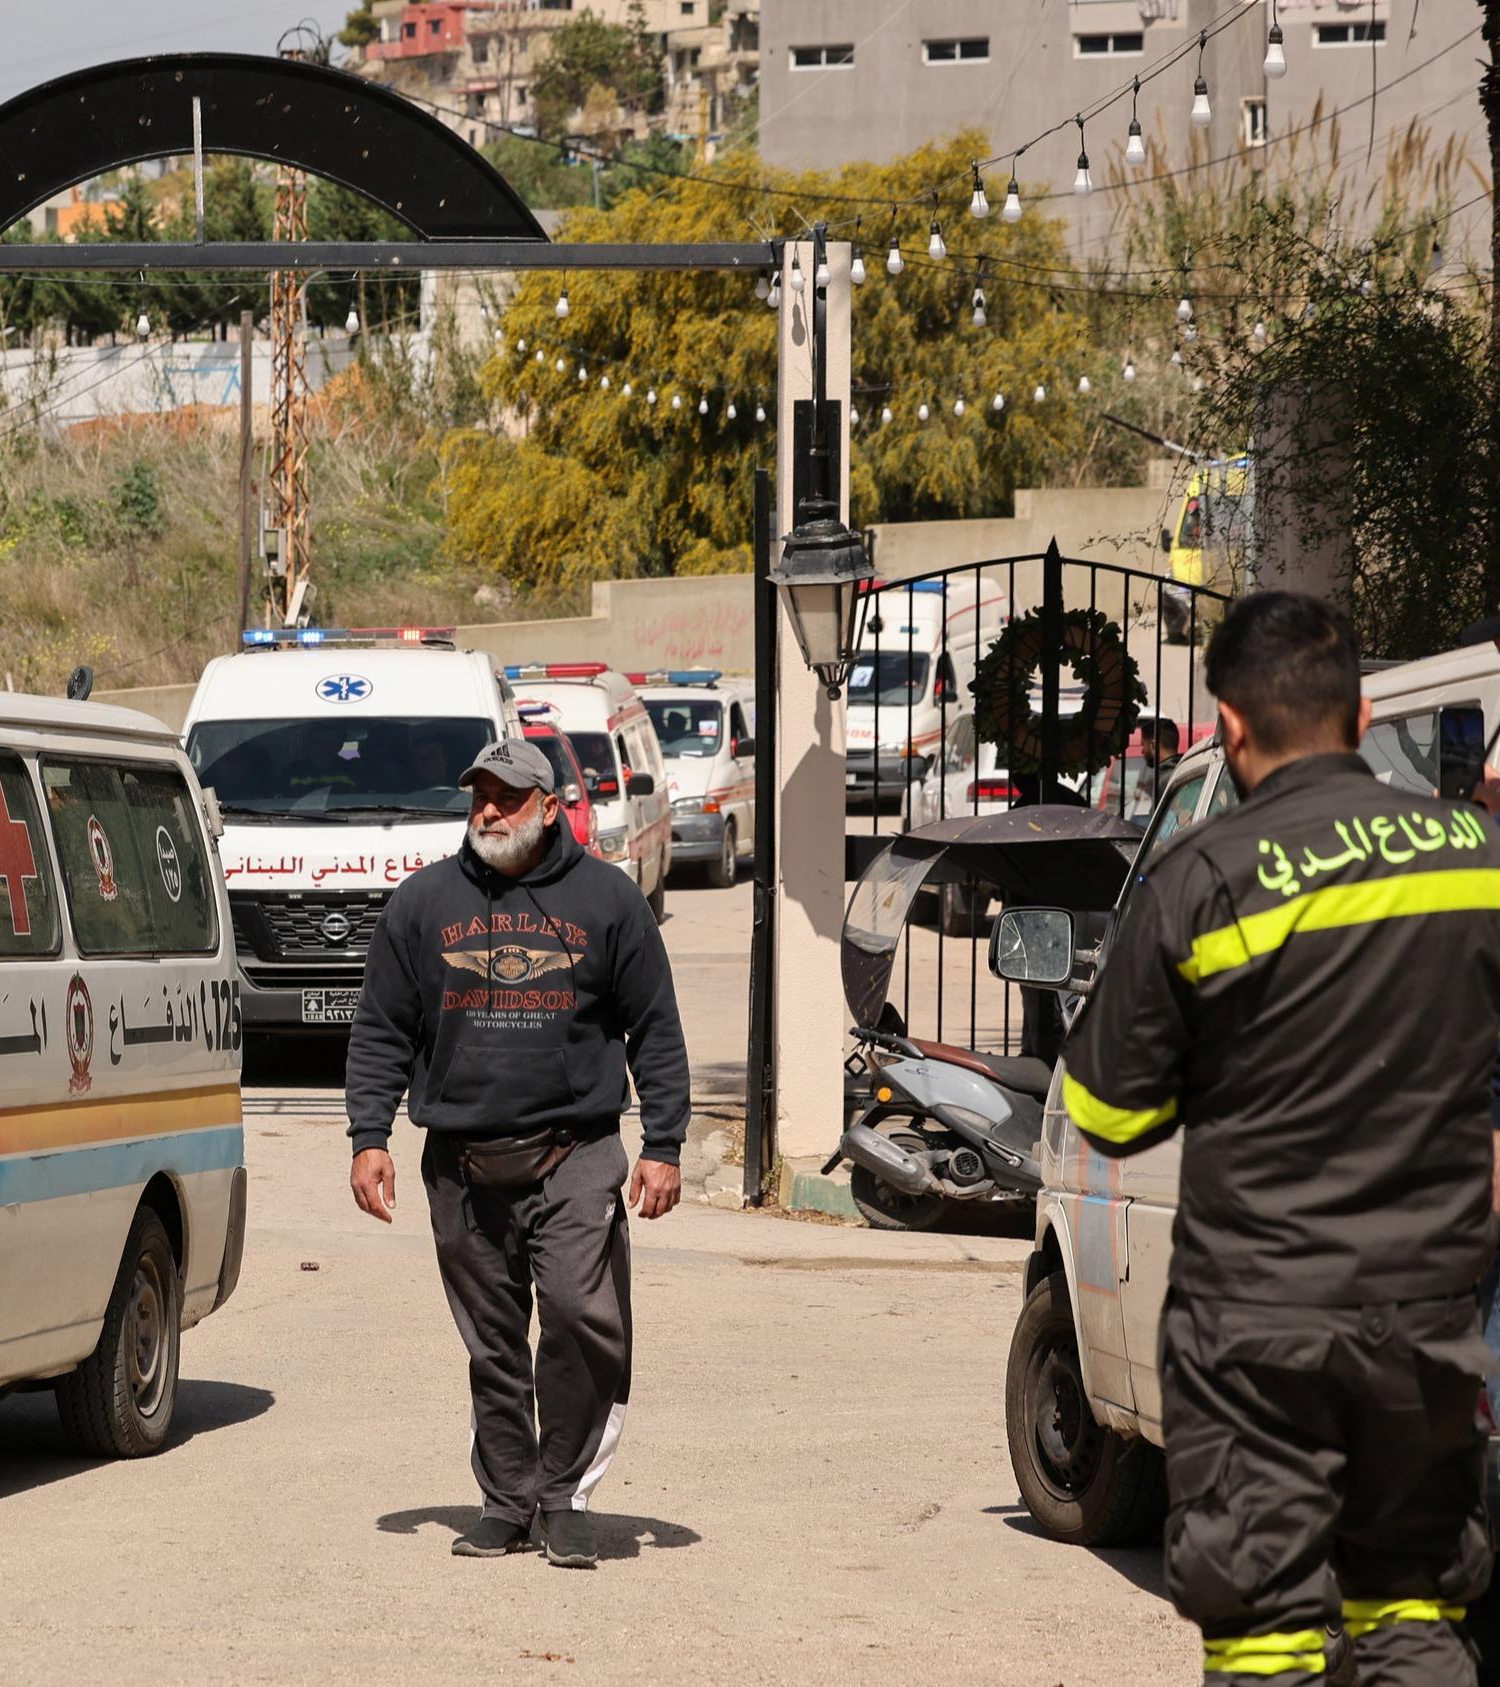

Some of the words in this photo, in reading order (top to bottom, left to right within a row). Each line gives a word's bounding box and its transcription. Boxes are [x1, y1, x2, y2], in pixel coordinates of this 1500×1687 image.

[1370, 809, 1486, 864] الدفاع
[311, 855, 375, 888] المدني
[1258, 816, 1373, 896] المدني
[441, 913, 587, 947] HARLEY
[211, 981, 242, 1051] 125
[443, 989, 579, 1010] DAVIDSON
[477, 1011, 507, 1019] YEARS
[523, 1012, 557, 1020] GREAT
[473, 1020, 543, 1029] MOTORCYCLES
